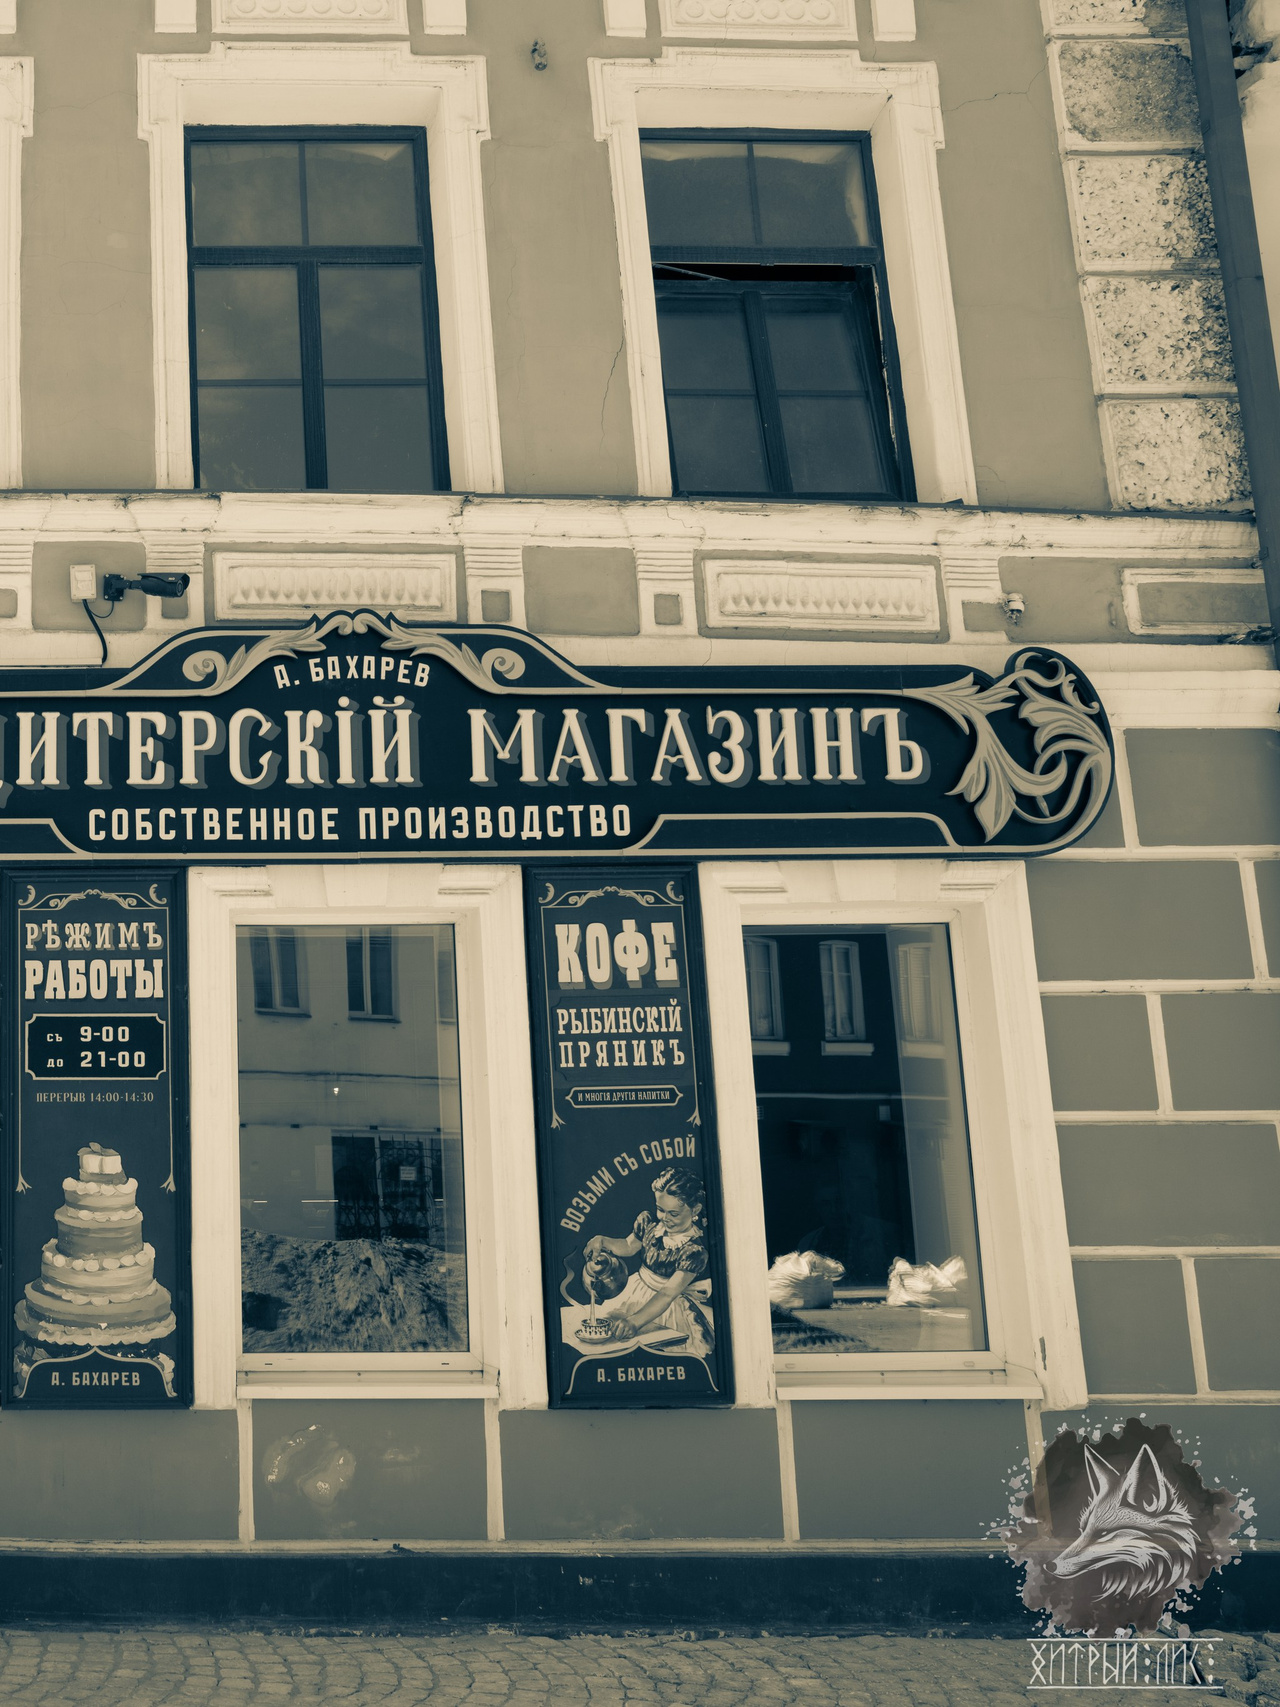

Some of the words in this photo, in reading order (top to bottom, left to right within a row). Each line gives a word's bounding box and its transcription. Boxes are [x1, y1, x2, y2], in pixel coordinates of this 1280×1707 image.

[274, 662, 301, 688] А.
[309, 655, 431, 688] БАХАРЕВ
[468, 705, 924, 783] МАГАЗИНЪ
[88, 807, 339, 842] СОБСТВЕННОЕ
[358, 804, 631, 840] ПРОИЗВОДСТВО
[555, 919, 680, 989] КОФЕ
[24, 958, 164, 1000] РАБОТЫ
[556, 998, 683, 1035] РЫБИНСКІЙ
[80, 1026, 130, 1042] 9-00
[80, 1051, 146, 1068] 21-00
[559, 1039, 685, 1068] ПРЯНИКЪ
[36, 1092, 86, 1102] ПЕРЕРЫВ
[90, 1092, 154, 1102] 14:00-14:30
[577, 1093, 584, 1102] И
[637, 1091, 670, 1101] НАПИТКИ
[560, 1166, 616, 1233] ВОЗЬМИ
[639, 1133, 696, 1164] СОБОЙ
[51, 1372, 65, 1386] А.
[72, 1371, 141, 1386] БАХАРЕВ
[597, 1369, 611, 1383] А.
[617, 1366, 686, 1382] БАХАРЕВ
